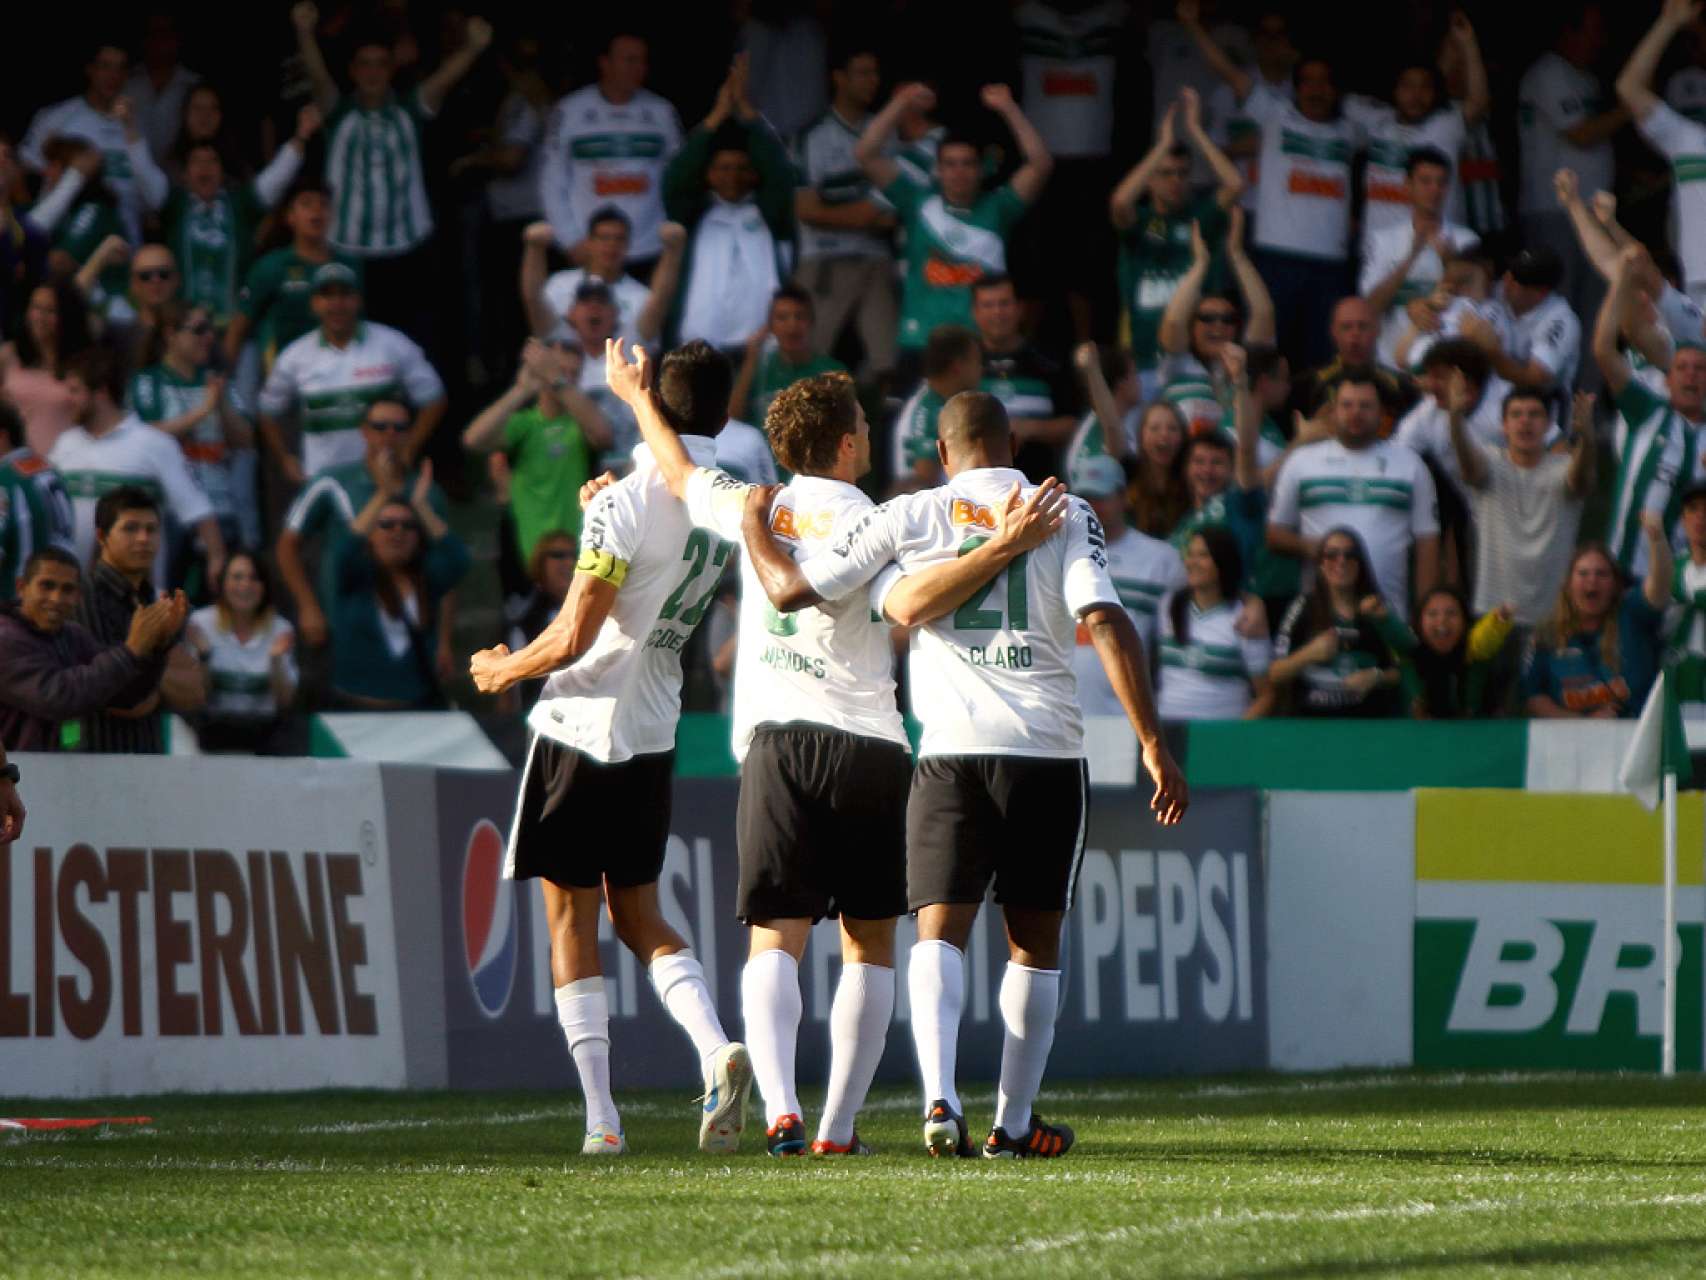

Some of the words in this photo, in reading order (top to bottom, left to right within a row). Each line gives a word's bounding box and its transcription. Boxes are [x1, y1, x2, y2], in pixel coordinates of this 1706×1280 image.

[969, 645, 1032, 669] CLARO
[0, 842, 379, 1041] LISTERINE
[1078, 848, 1252, 1022] PEPSI
[1446, 917, 1684, 1036] BR
